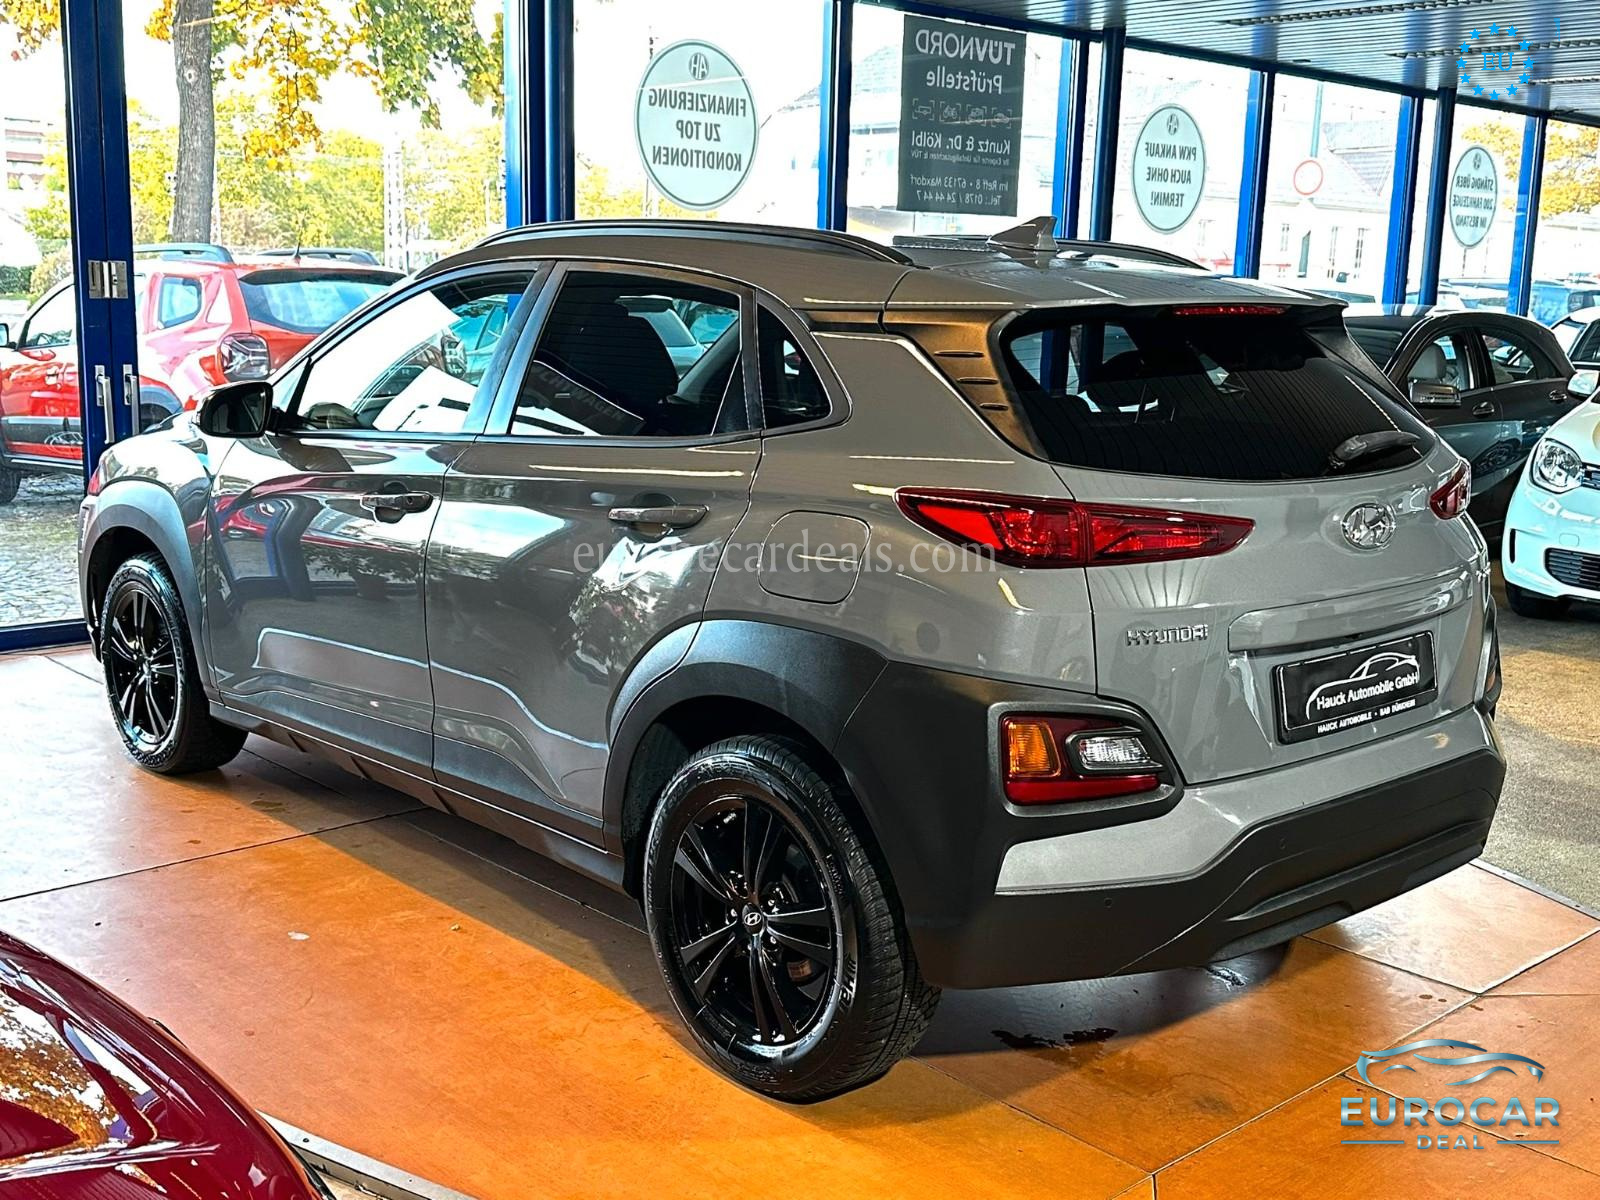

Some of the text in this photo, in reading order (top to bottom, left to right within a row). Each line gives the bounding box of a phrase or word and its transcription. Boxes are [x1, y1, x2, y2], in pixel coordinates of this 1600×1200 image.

[1127, 624, 1208, 646] HYUNDAI
[1316, 672, 1419, 711] Hauck Automobile GmbH
[1317, 721, 1339, 734] HAUCK
